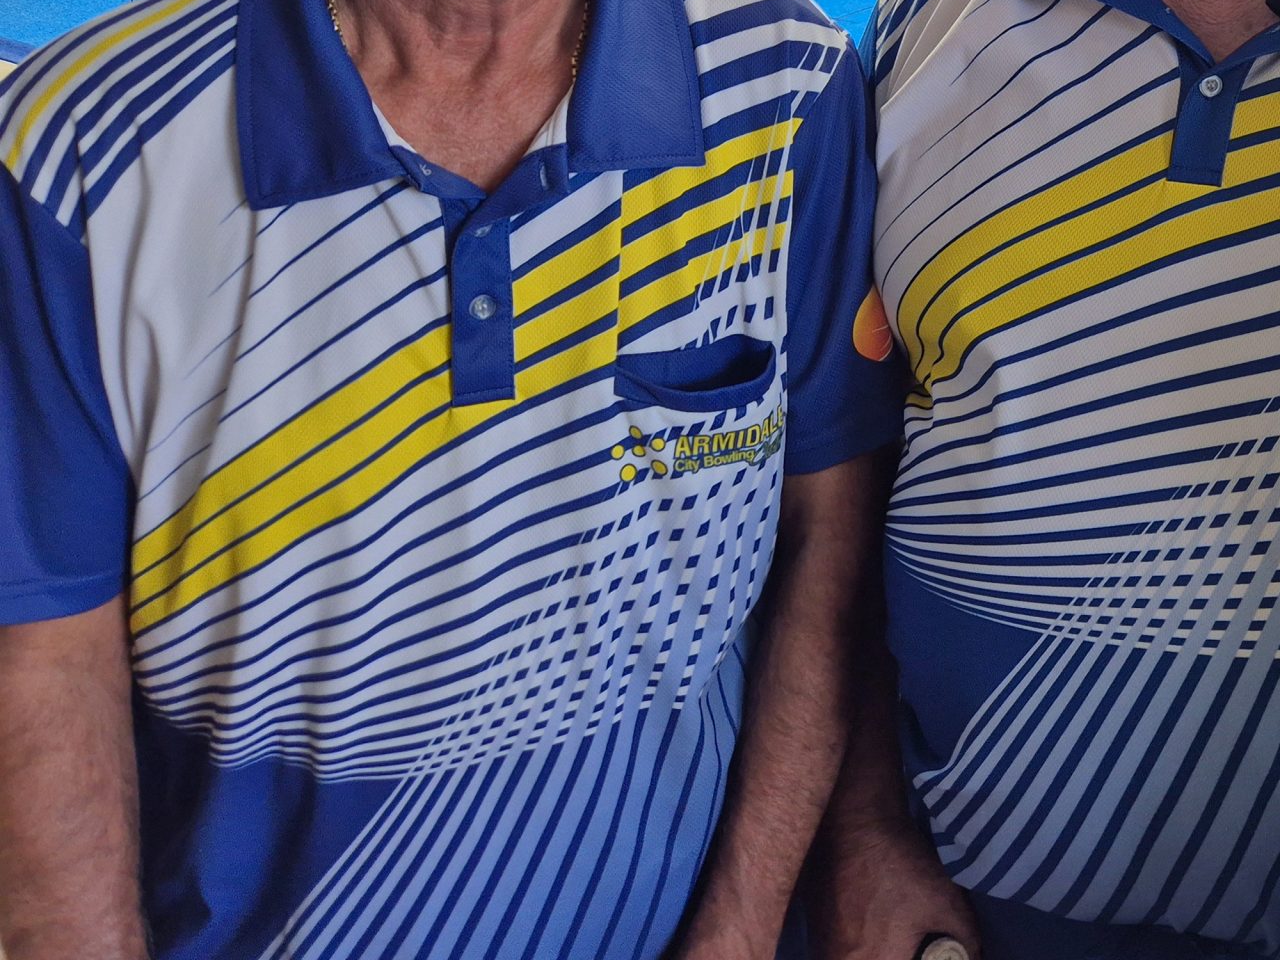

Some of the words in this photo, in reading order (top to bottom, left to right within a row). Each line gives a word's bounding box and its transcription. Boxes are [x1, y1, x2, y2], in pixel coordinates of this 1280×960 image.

[674, 405, 785, 460] ARMIDALE
[674, 459, 700, 474] City
[703, 448, 756, 469] Bowling
